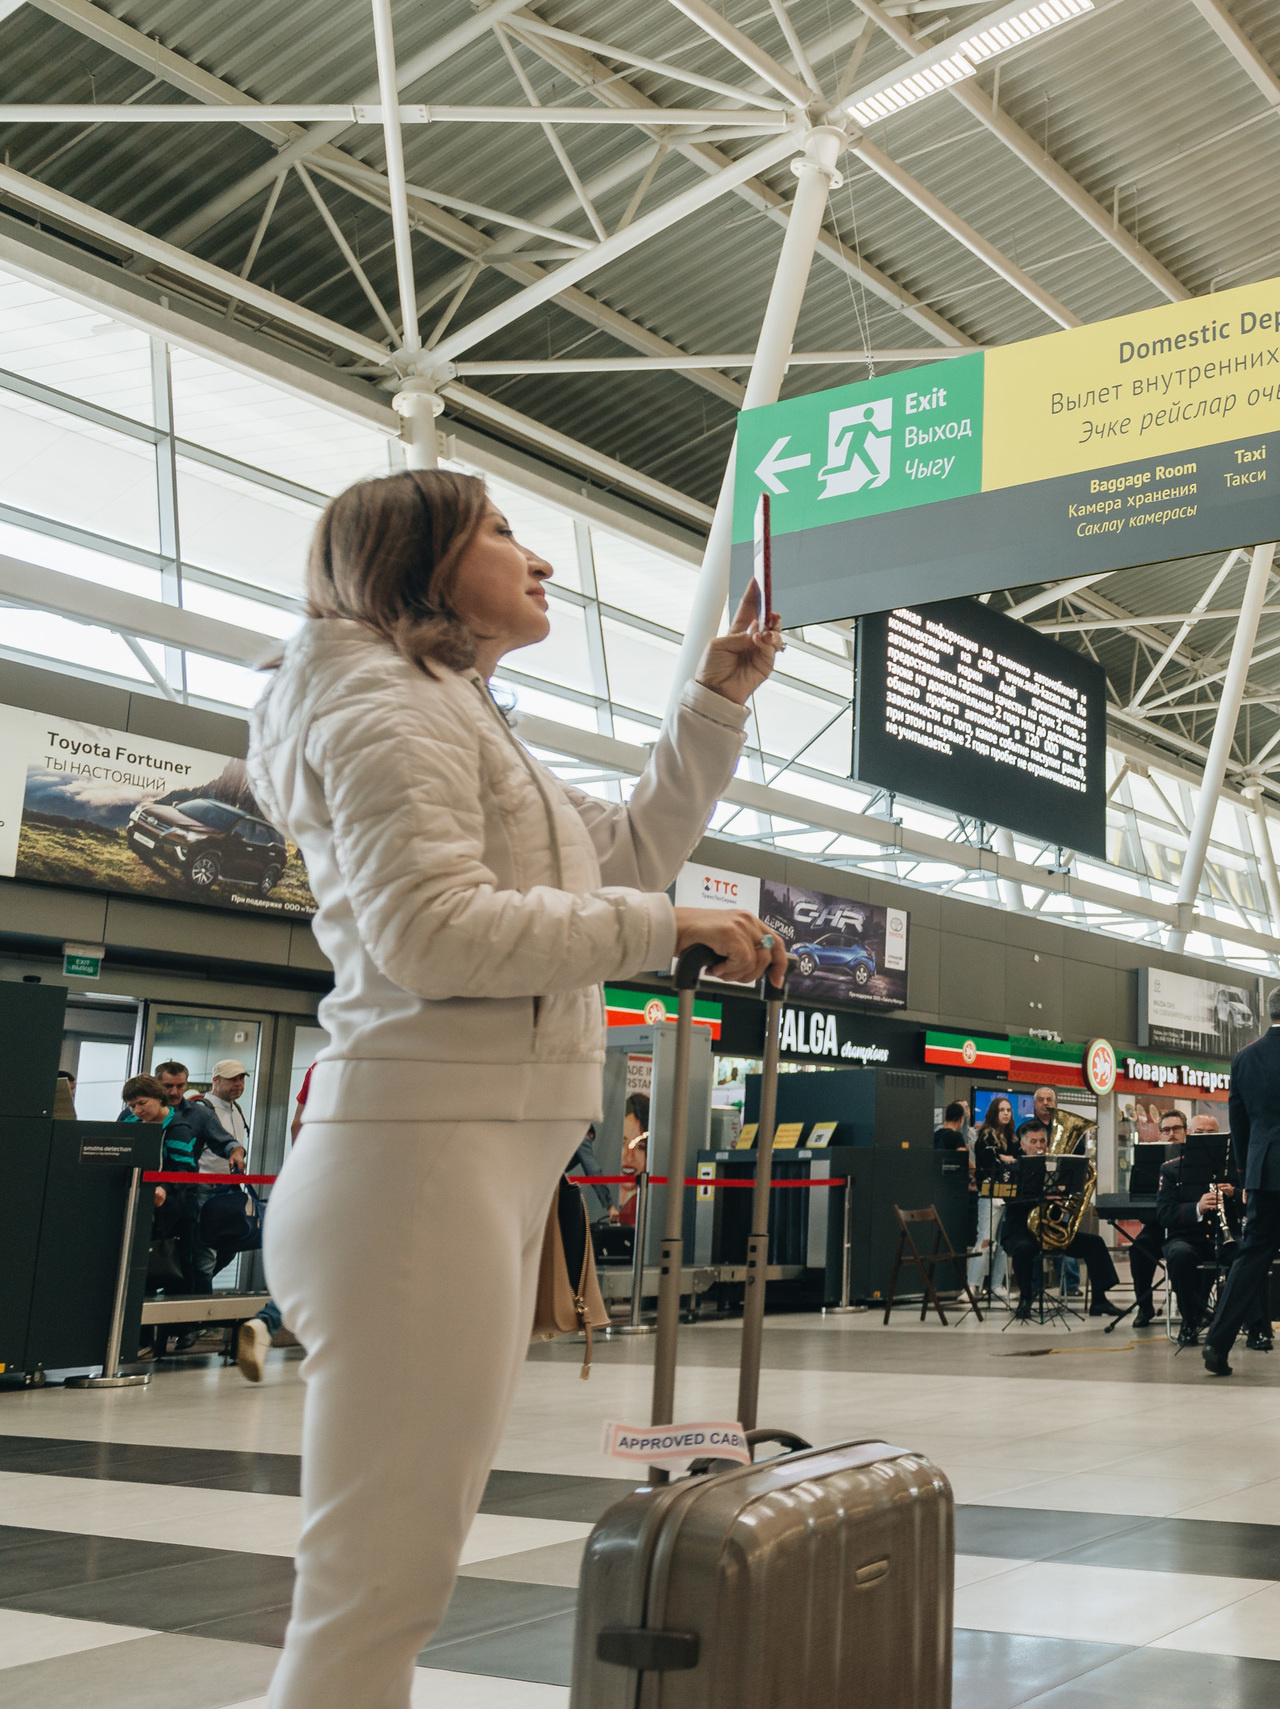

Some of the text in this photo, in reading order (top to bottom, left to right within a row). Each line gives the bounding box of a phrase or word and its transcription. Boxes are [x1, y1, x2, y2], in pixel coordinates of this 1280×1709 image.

[1119, 319, 1230, 364] Domestic
[1051, 384, 1123, 414] Вылет
[1132, 346, 1279, 395] внутренних
[906, 388, 947, 414] Exit
[1078, 416, 1132, 444] Эчке
[1140, 393, 1236, 435] рейслар
[905, 418, 972, 448] Выход
[905, 456, 956, 480] Чыгу
[1234, 445, 1266, 464] Taxi
[1090, 461, 1197, 494] Baggage Room
[1224, 470, 1266, 488] Такси
[1068, 483, 1197, 518] Камера хранения
[1076, 504, 1198, 537] Саклау камерасы
[893, 608, 922, 626] олная
[926, 620, 978, 653] информация
[888, 632, 939, 663] автомобили
[999, 680, 1016, 698] Audi
[887, 661, 914, 681] также
[995, 705, 1001, 718] 2
[886, 691, 941, 722] зависимости
[942, 714, 953, 726] от
[887, 676, 920, 698] общего
[926, 693, 959, 715] пробега
[1025, 732, 1040, 748] 120
[886, 721, 898, 735] не
[886, 706, 904, 722] при
[905, 714, 926, 730] этом
[926, 722, 933, 733] в
[964, 734, 972, 748] 2
[972, 740, 990, 756] года
[48, 732, 192, 775] Toyota Fortuner
[44, 756, 166, 792] ТЫ НАСТОЯЩИЙ
[841, 1041, 889, 1064] champions
[1127, 1058, 1177, 1088] Товары
[618, 1433, 704, 1450] APPROVED
